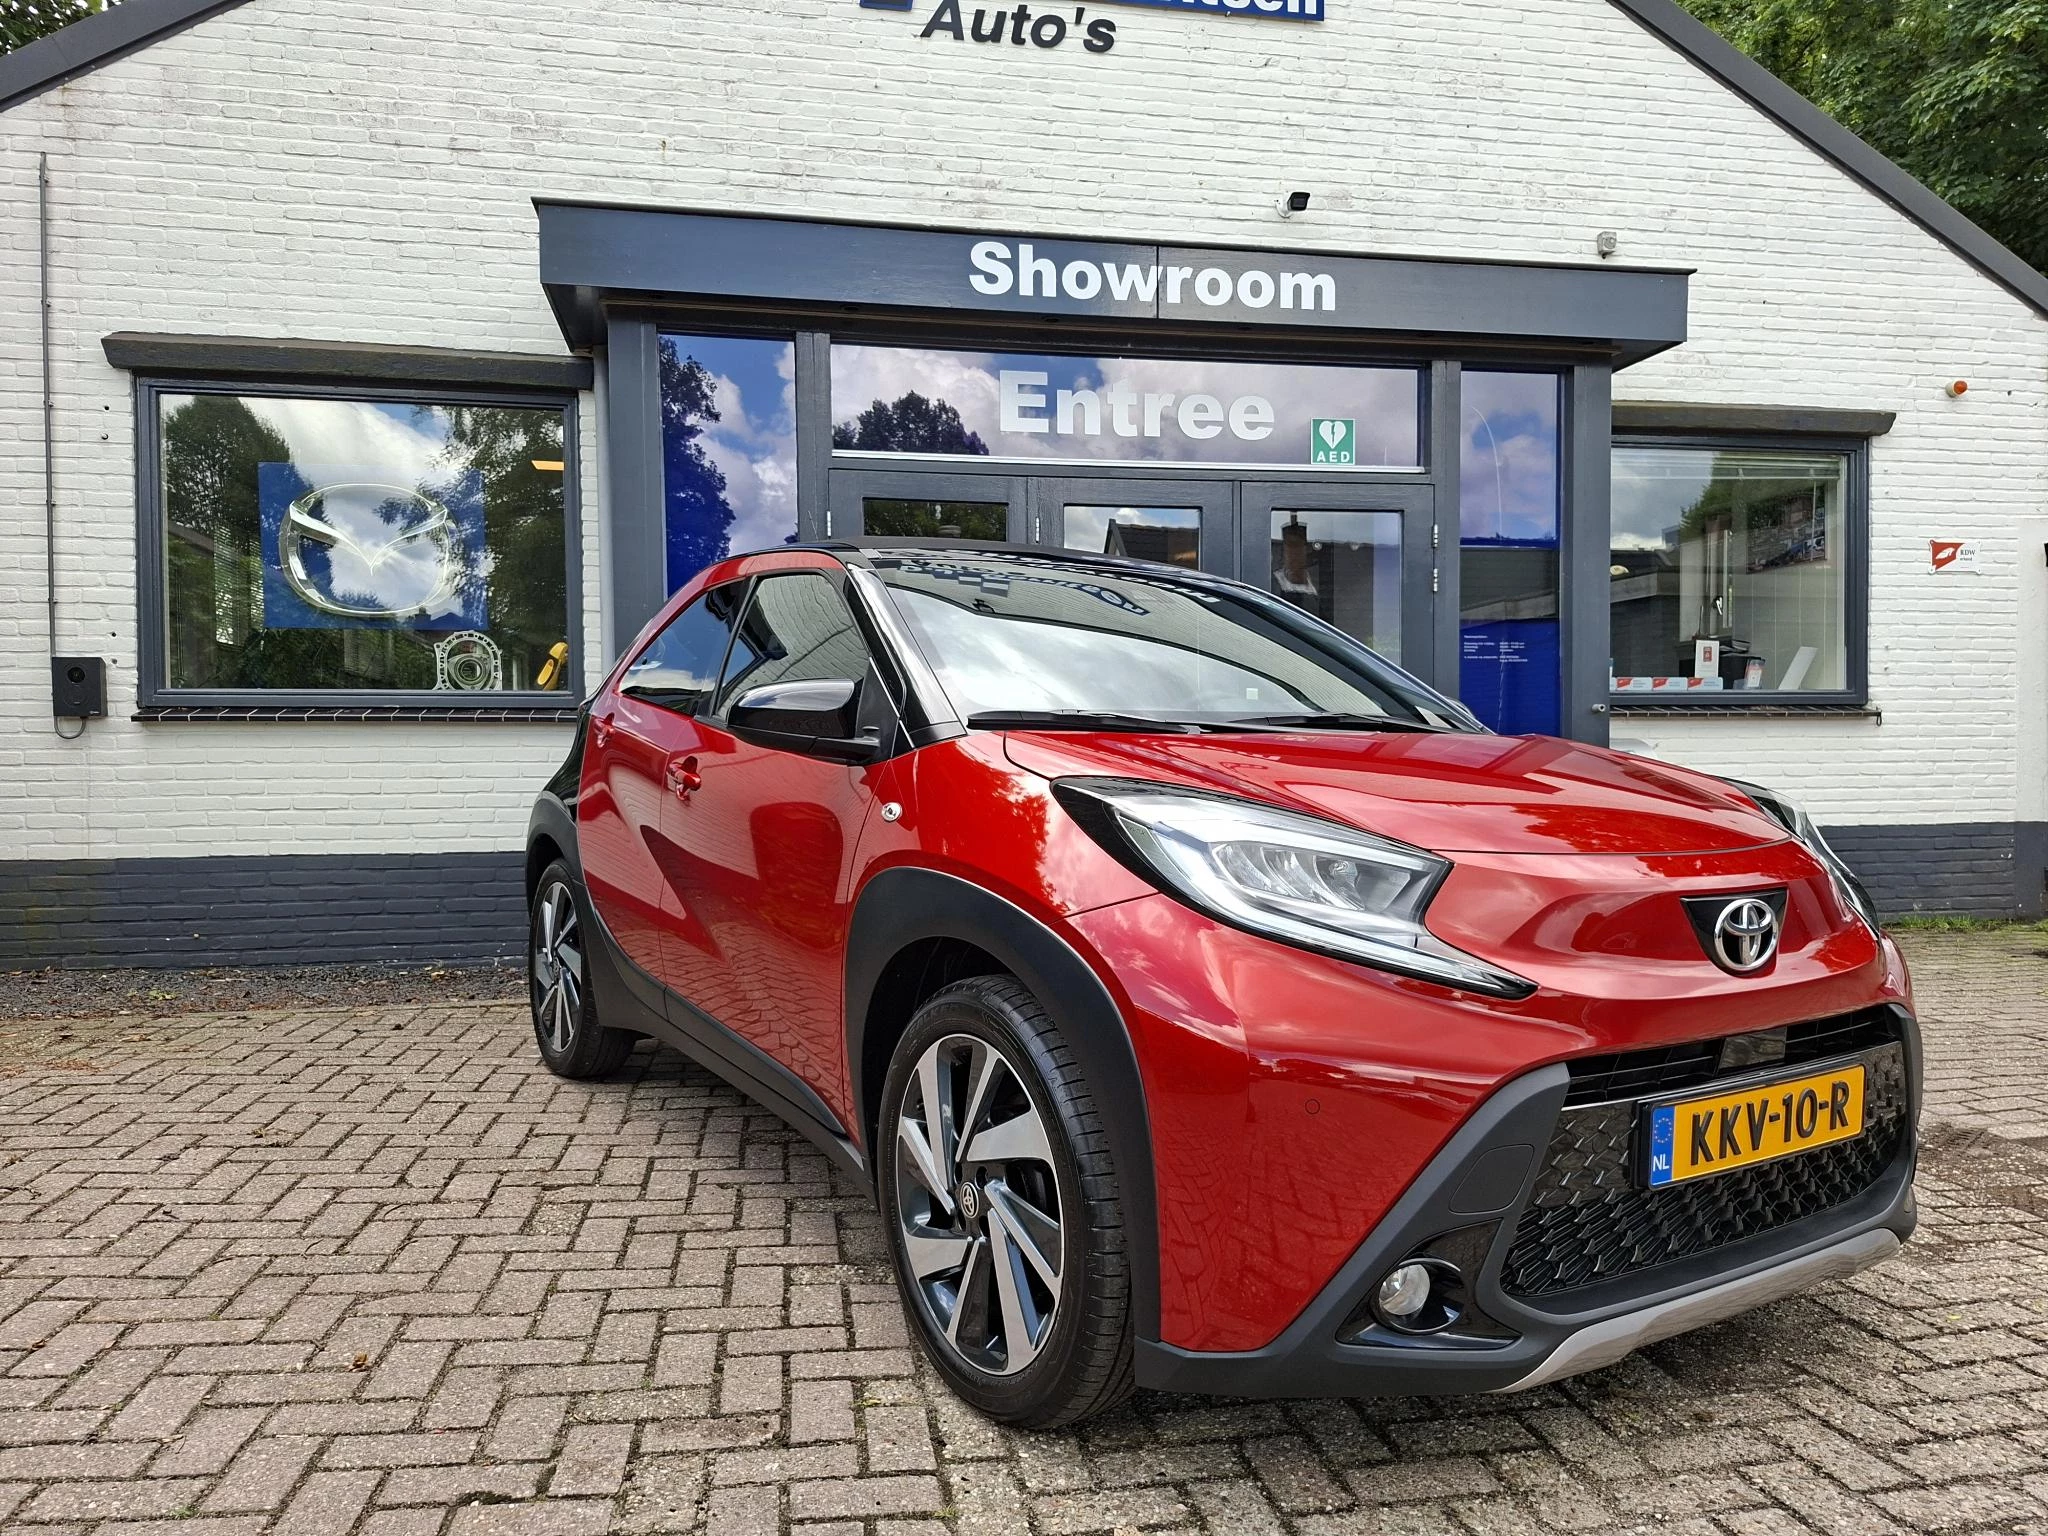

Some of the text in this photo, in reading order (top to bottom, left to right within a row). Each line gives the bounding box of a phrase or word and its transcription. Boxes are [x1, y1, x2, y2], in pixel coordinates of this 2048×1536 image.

[920, 0, 1116, 53] Auto's
[969, 241, 1336, 311] Showroom
[999, 369, 1275, 440] Entree
[1316, 450, 1350, 463] AED
[1690, 1080, 1850, 1166] KKV-10-R
[1652, 1153, 1669, 1172] NL
